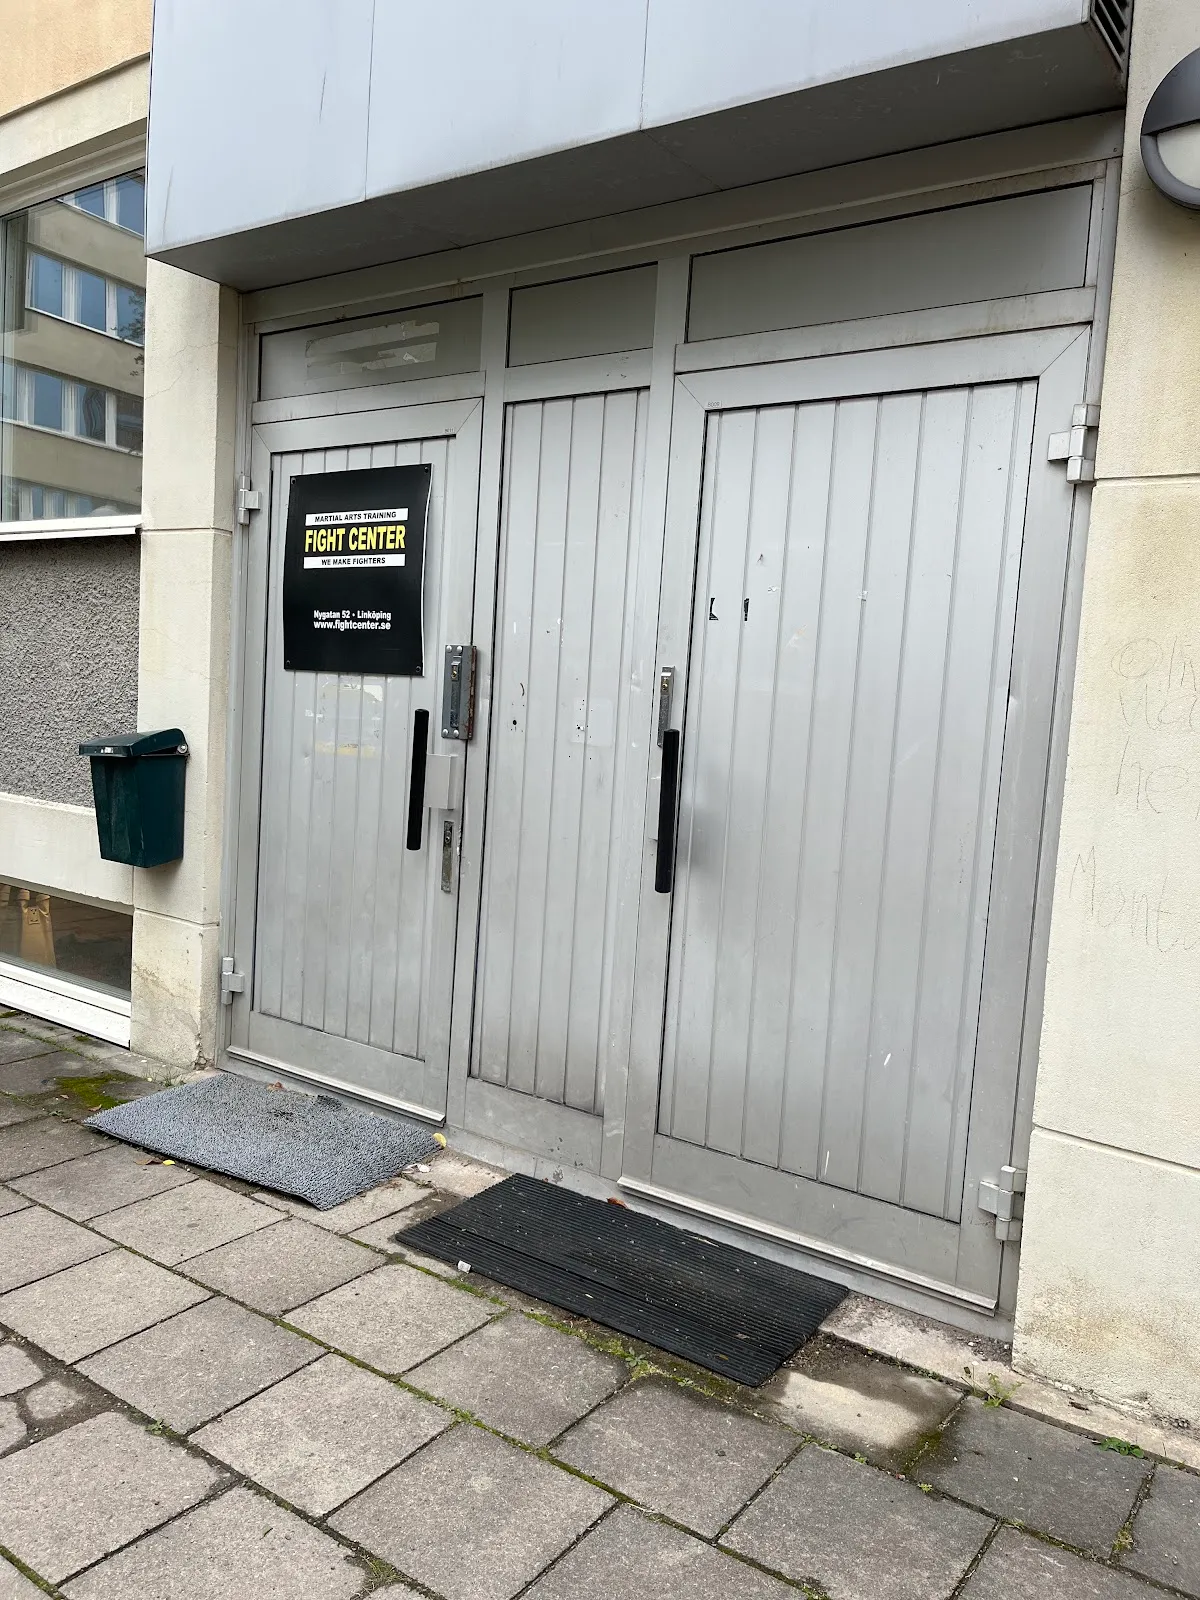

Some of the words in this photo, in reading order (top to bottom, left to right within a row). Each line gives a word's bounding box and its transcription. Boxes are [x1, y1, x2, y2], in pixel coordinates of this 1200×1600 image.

[315, 514, 342, 523] MARTIAL
[344, 513, 362, 521] ARTS
[363, 511, 397, 520] TRAINING
[304, 527, 346, 552] FIGHT
[348, 525, 406, 551] CENTER
[332, 558, 351, 566] MAKE
[352, 557, 386, 565] FIGHTERS
[313, 610, 340, 620] Nygatan
[341, 610, 351, 619] 52
[357, 610, 392, 621] Linköping
[313, 620, 391, 631] www.fightcenter.se
